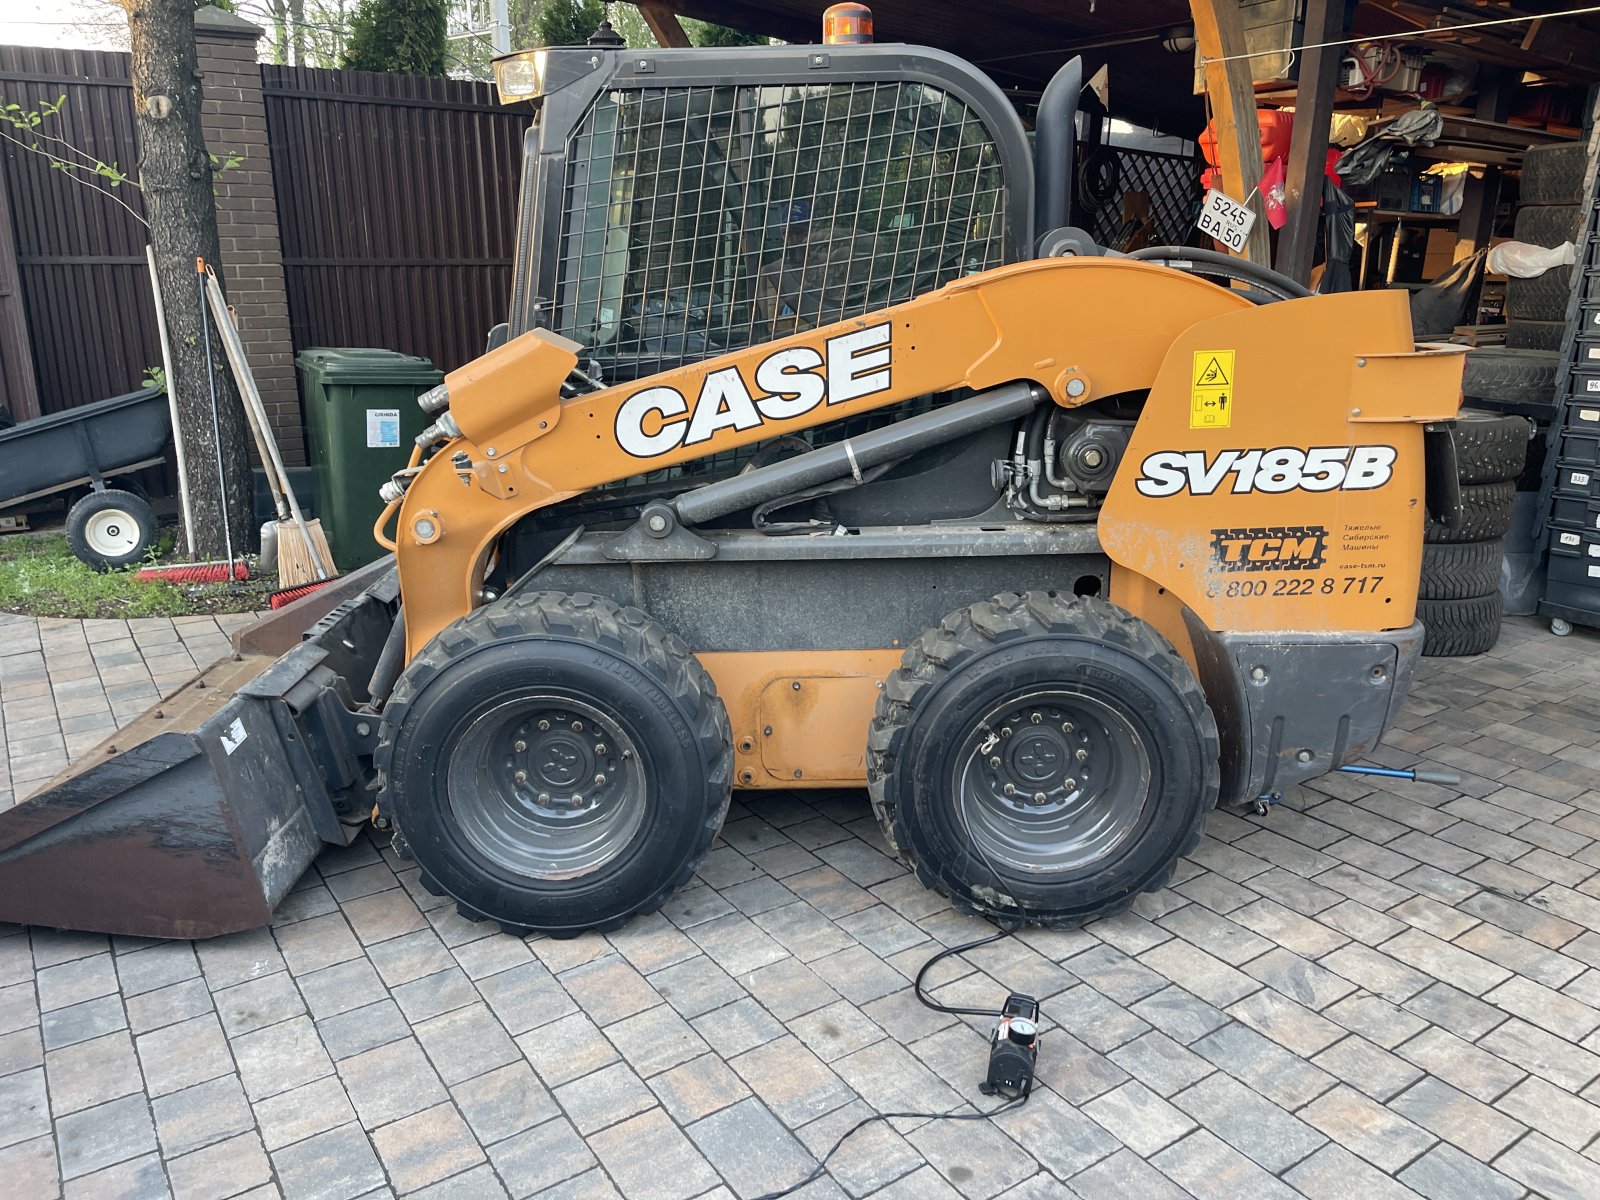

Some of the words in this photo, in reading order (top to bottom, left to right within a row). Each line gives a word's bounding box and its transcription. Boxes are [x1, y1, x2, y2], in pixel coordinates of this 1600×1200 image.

[1212, 196, 1247, 226] 5245
[1224, 228, 1242, 247] 50
[614, 320, 892, 458] CASE
[1135, 445, 1398, 498] SV185B
[1341, 543, 1379, 551] Машины
[1342, 533, 1390, 541] Сибирские
[1226, 579, 1267, 598] 800
[1272, 578, 1315, 597] 222
[1321, 577, 1335, 594] 8
[1342, 576, 1384, 594] 717
